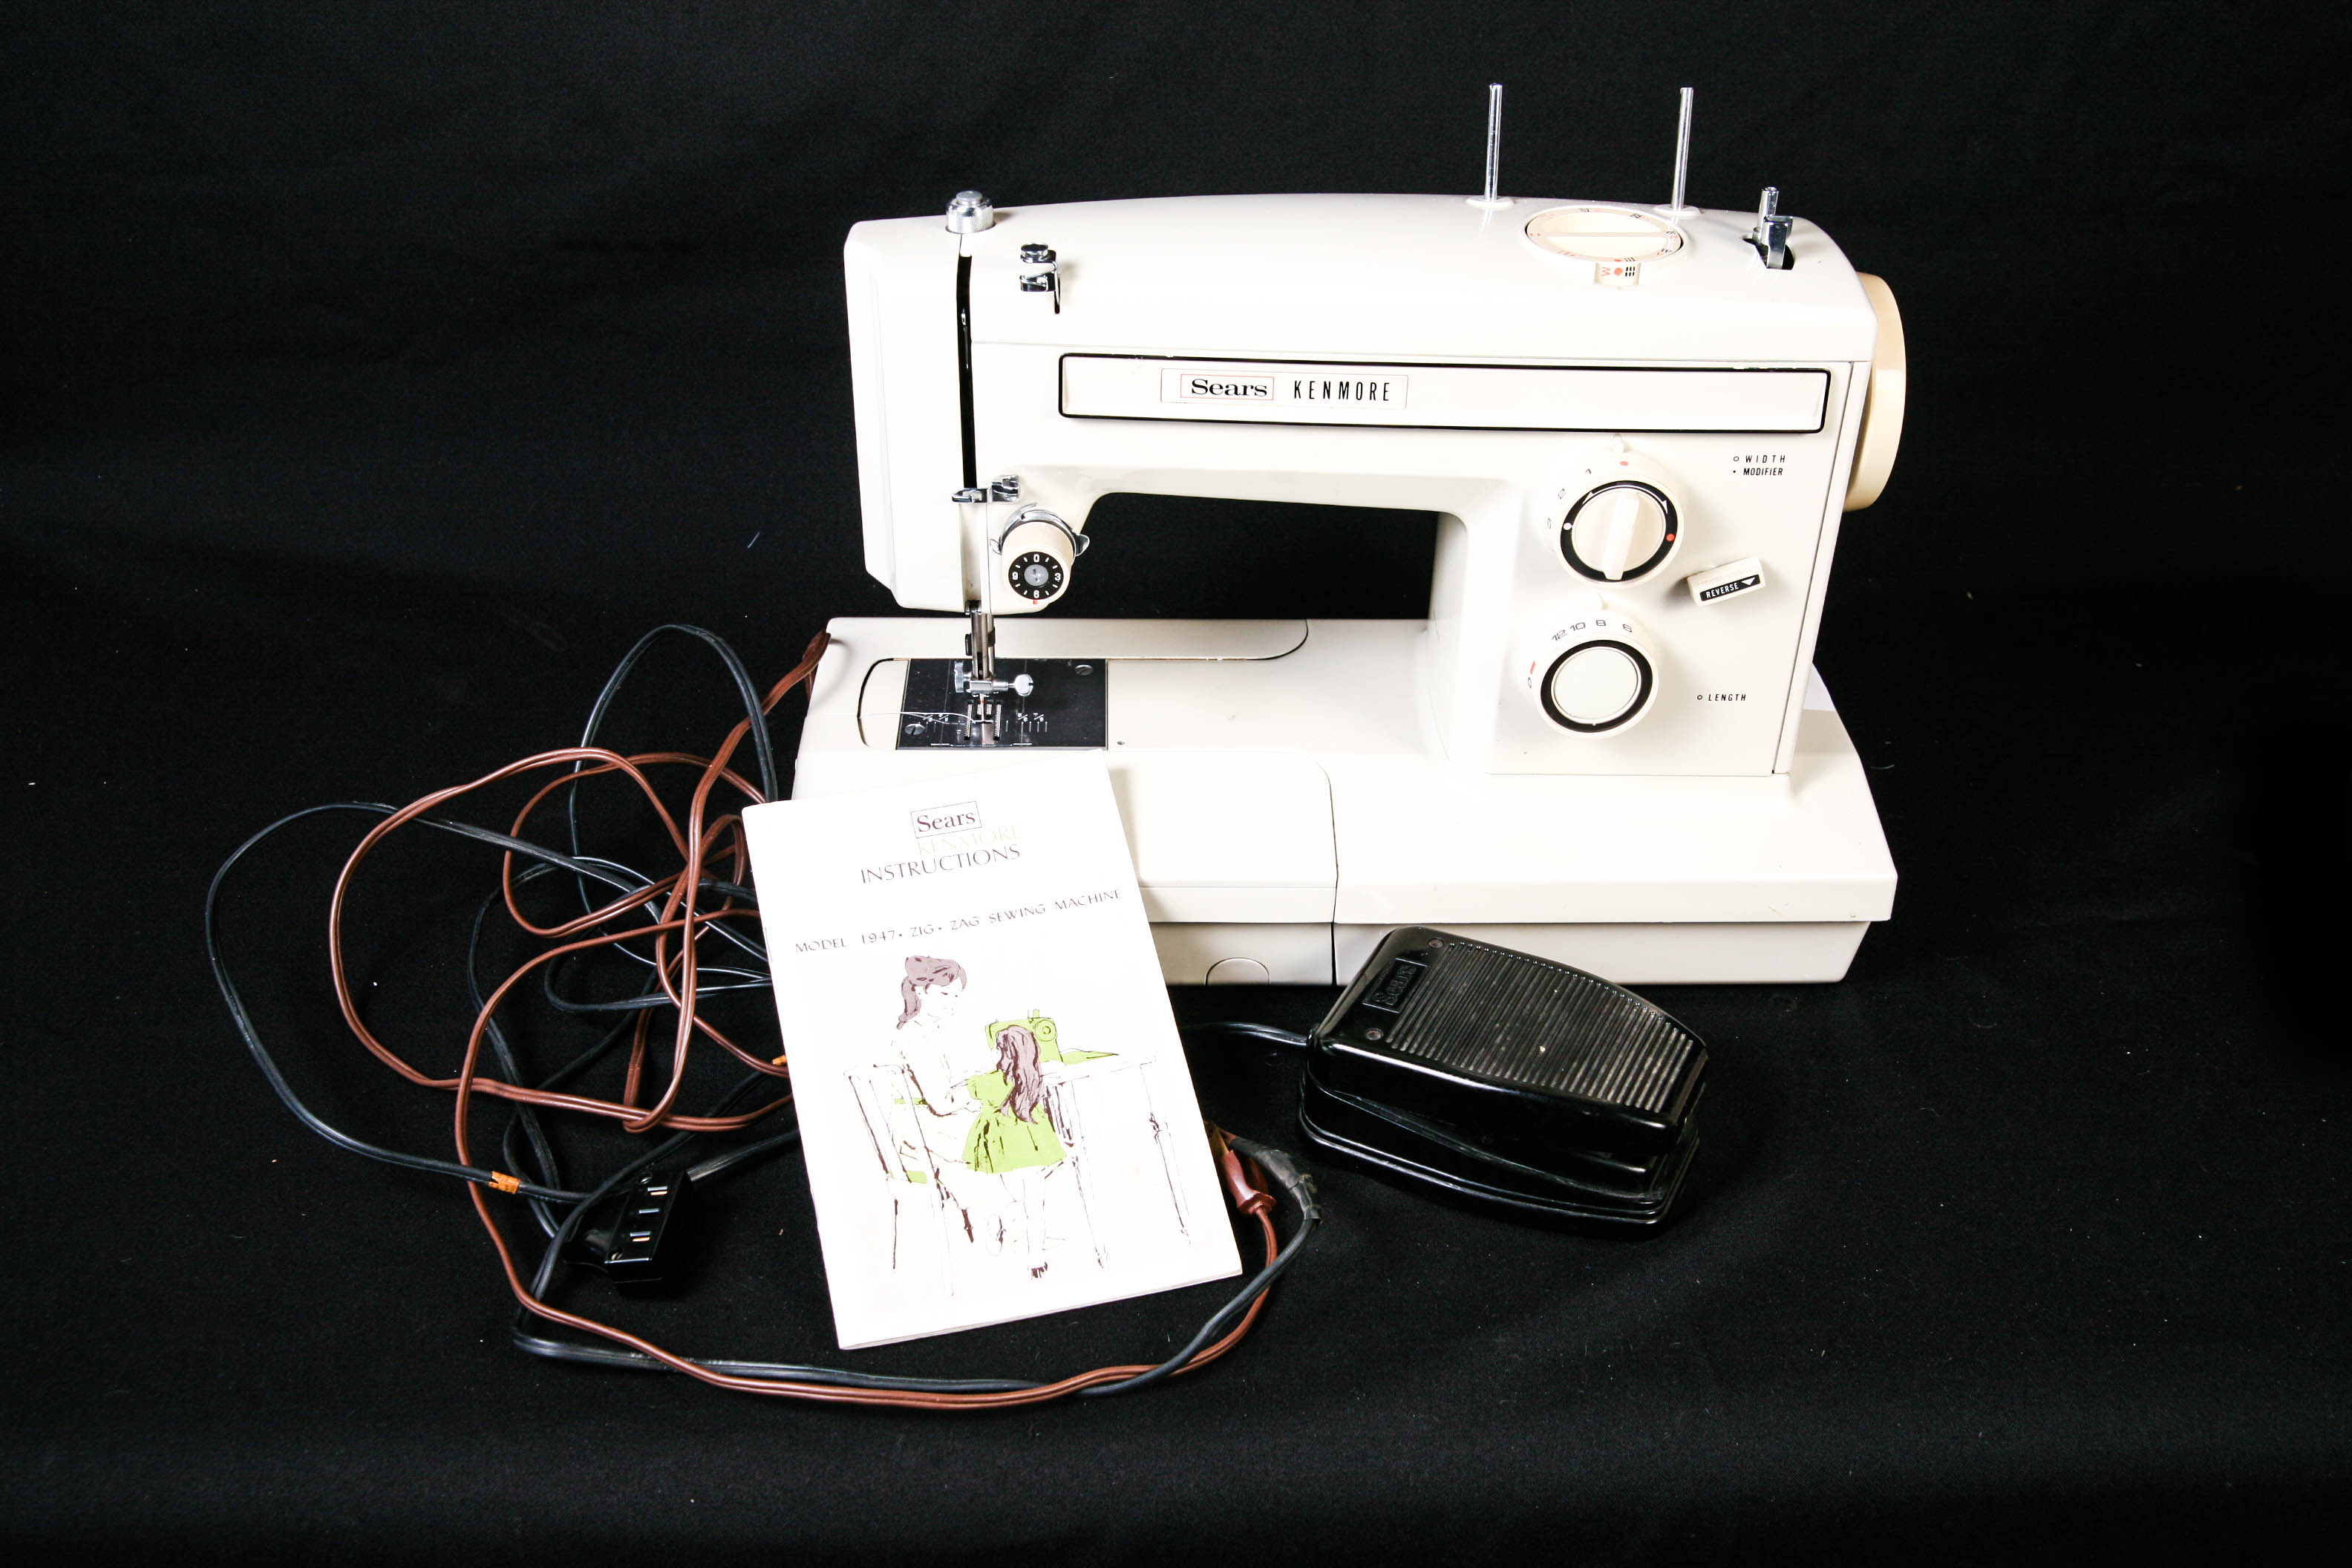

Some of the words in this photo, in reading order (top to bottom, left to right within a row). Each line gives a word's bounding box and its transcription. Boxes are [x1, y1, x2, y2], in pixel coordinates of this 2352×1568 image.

[1191, 379, 1267, 396] Sears
[1294, 380, 1390, 402] KENMORE
[1745, 454, 1786, 463] WIDTH
[1742, 467, 1784, 476] MODIFIER
[1033, 554, 1040, 563] 0
[1012, 572, 1019, 581] 9
[1054, 572, 1061, 581] 3
[1033, 589, 1040, 598] 6
[1705, 582, 1740, 599] REVERSE
[1552, 629, 1567, 641] 12
[1569, 621, 1587, 632] 10
[1708, 693, 1747, 702] LENGTH
[916, 811, 976, 832] Sears
[860, 844, 1021, 884] INSTRUCTIONS
[795, 937, 848, 953] MODEL
[950, 916, 980, 931] ZAG
[988, 903, 1047, 924] SEWING
[1054, 889, 1123, 912] MACHINE
